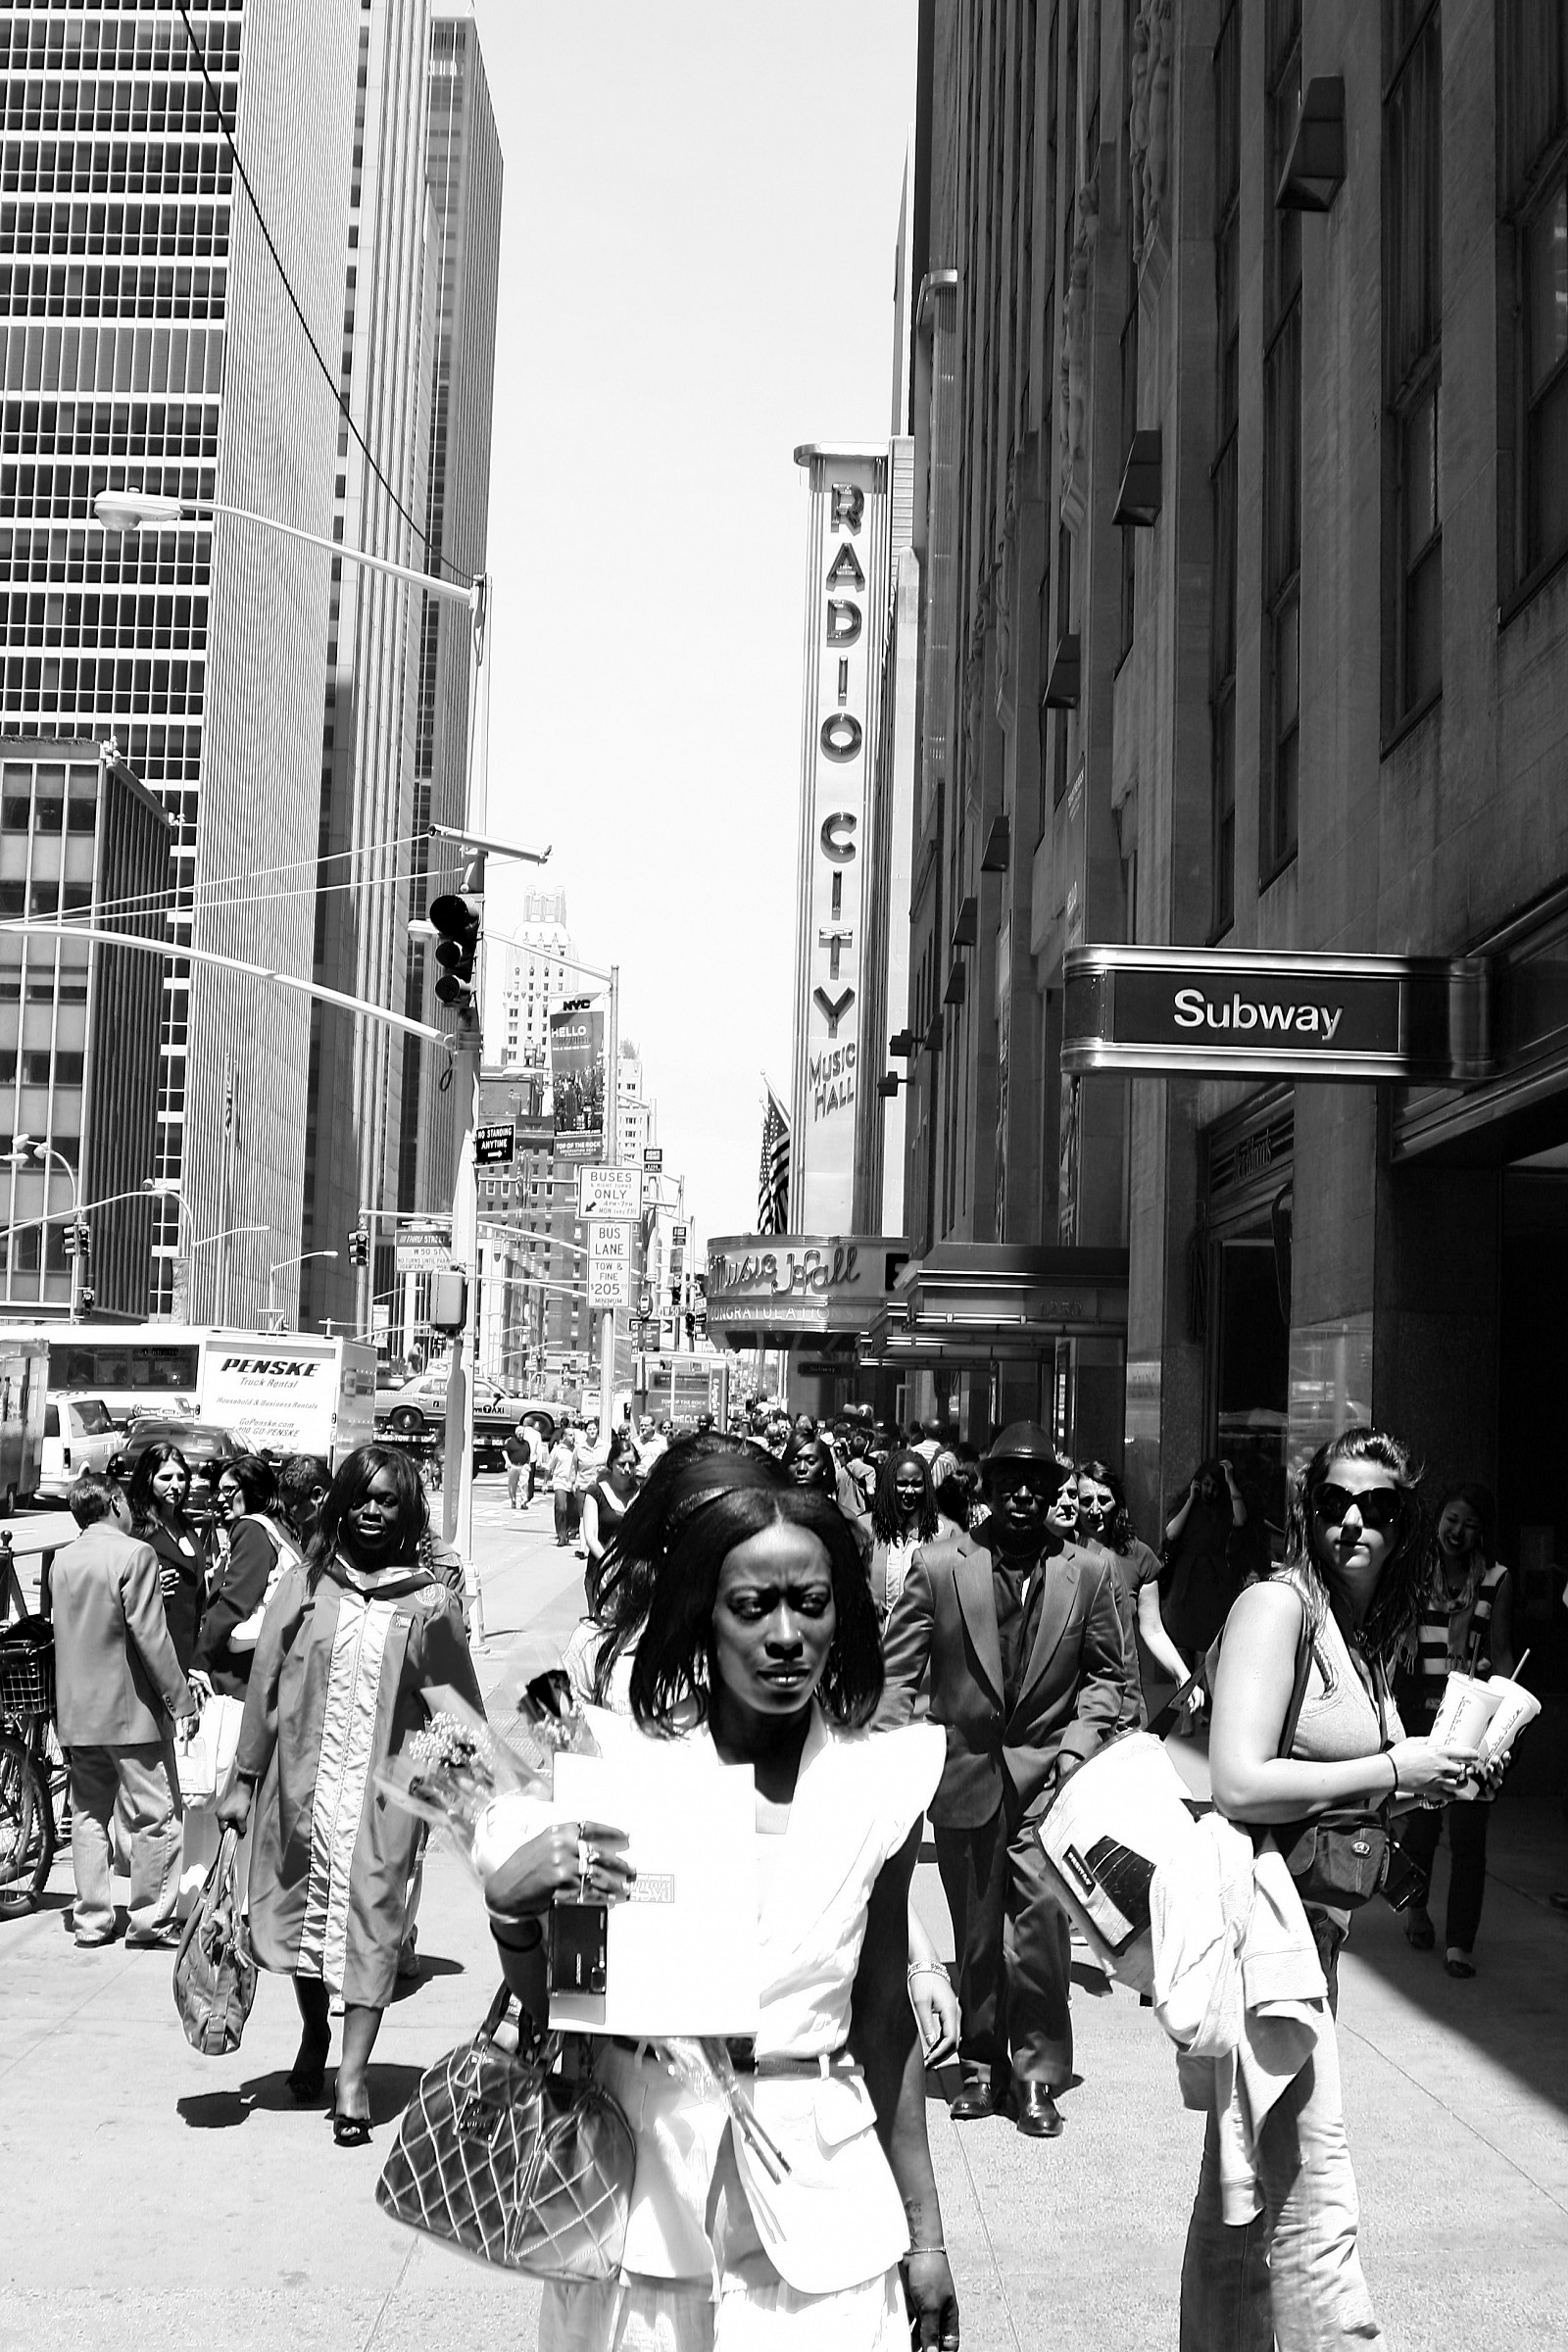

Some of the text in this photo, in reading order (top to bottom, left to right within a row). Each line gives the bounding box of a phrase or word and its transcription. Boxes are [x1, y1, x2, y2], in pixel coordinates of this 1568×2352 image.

[812, 482, 865, 1040] RADIO CITY
[563, 1000, 590, 1010] NYC
[1173, 988, 1344, 1041] Subway
[551, 1025, 587, 1039] HELLO
[814, 1076, 855, 1123] HALL
[477, 1126, 513, 1140] NO STANDING
[480, 1138, 508, 1151] ANYTIME
[590, 1171, 632, 1183] BUSES
[594, 1189, 627, 1200] ONLY
[599, 1227, 620, 1239] BUS
[406, 1235, 423, 1244] THRU
[595, 1244, 624, 1255] LANE
[596, 1262, 623, 1271] TOW &
[708, 1246, 861, 1296] Music Hall
[599, 1272, 618, 1281] FINE
[220, 1358, 321, 1377] PENSKE
[240, 1377, 299, 1389] Truck Rental
[217, 1396, 253, 1406] Household
[261, 1399, 291, 1408] Business
[291, 1401, 318, 1410] Rentals
[483, 1404, 505, 1414] TAXI
[239, 1418, 296, 1429] GoPenske.com
[253, 1428, 301, 1438] GO-PENSKE
